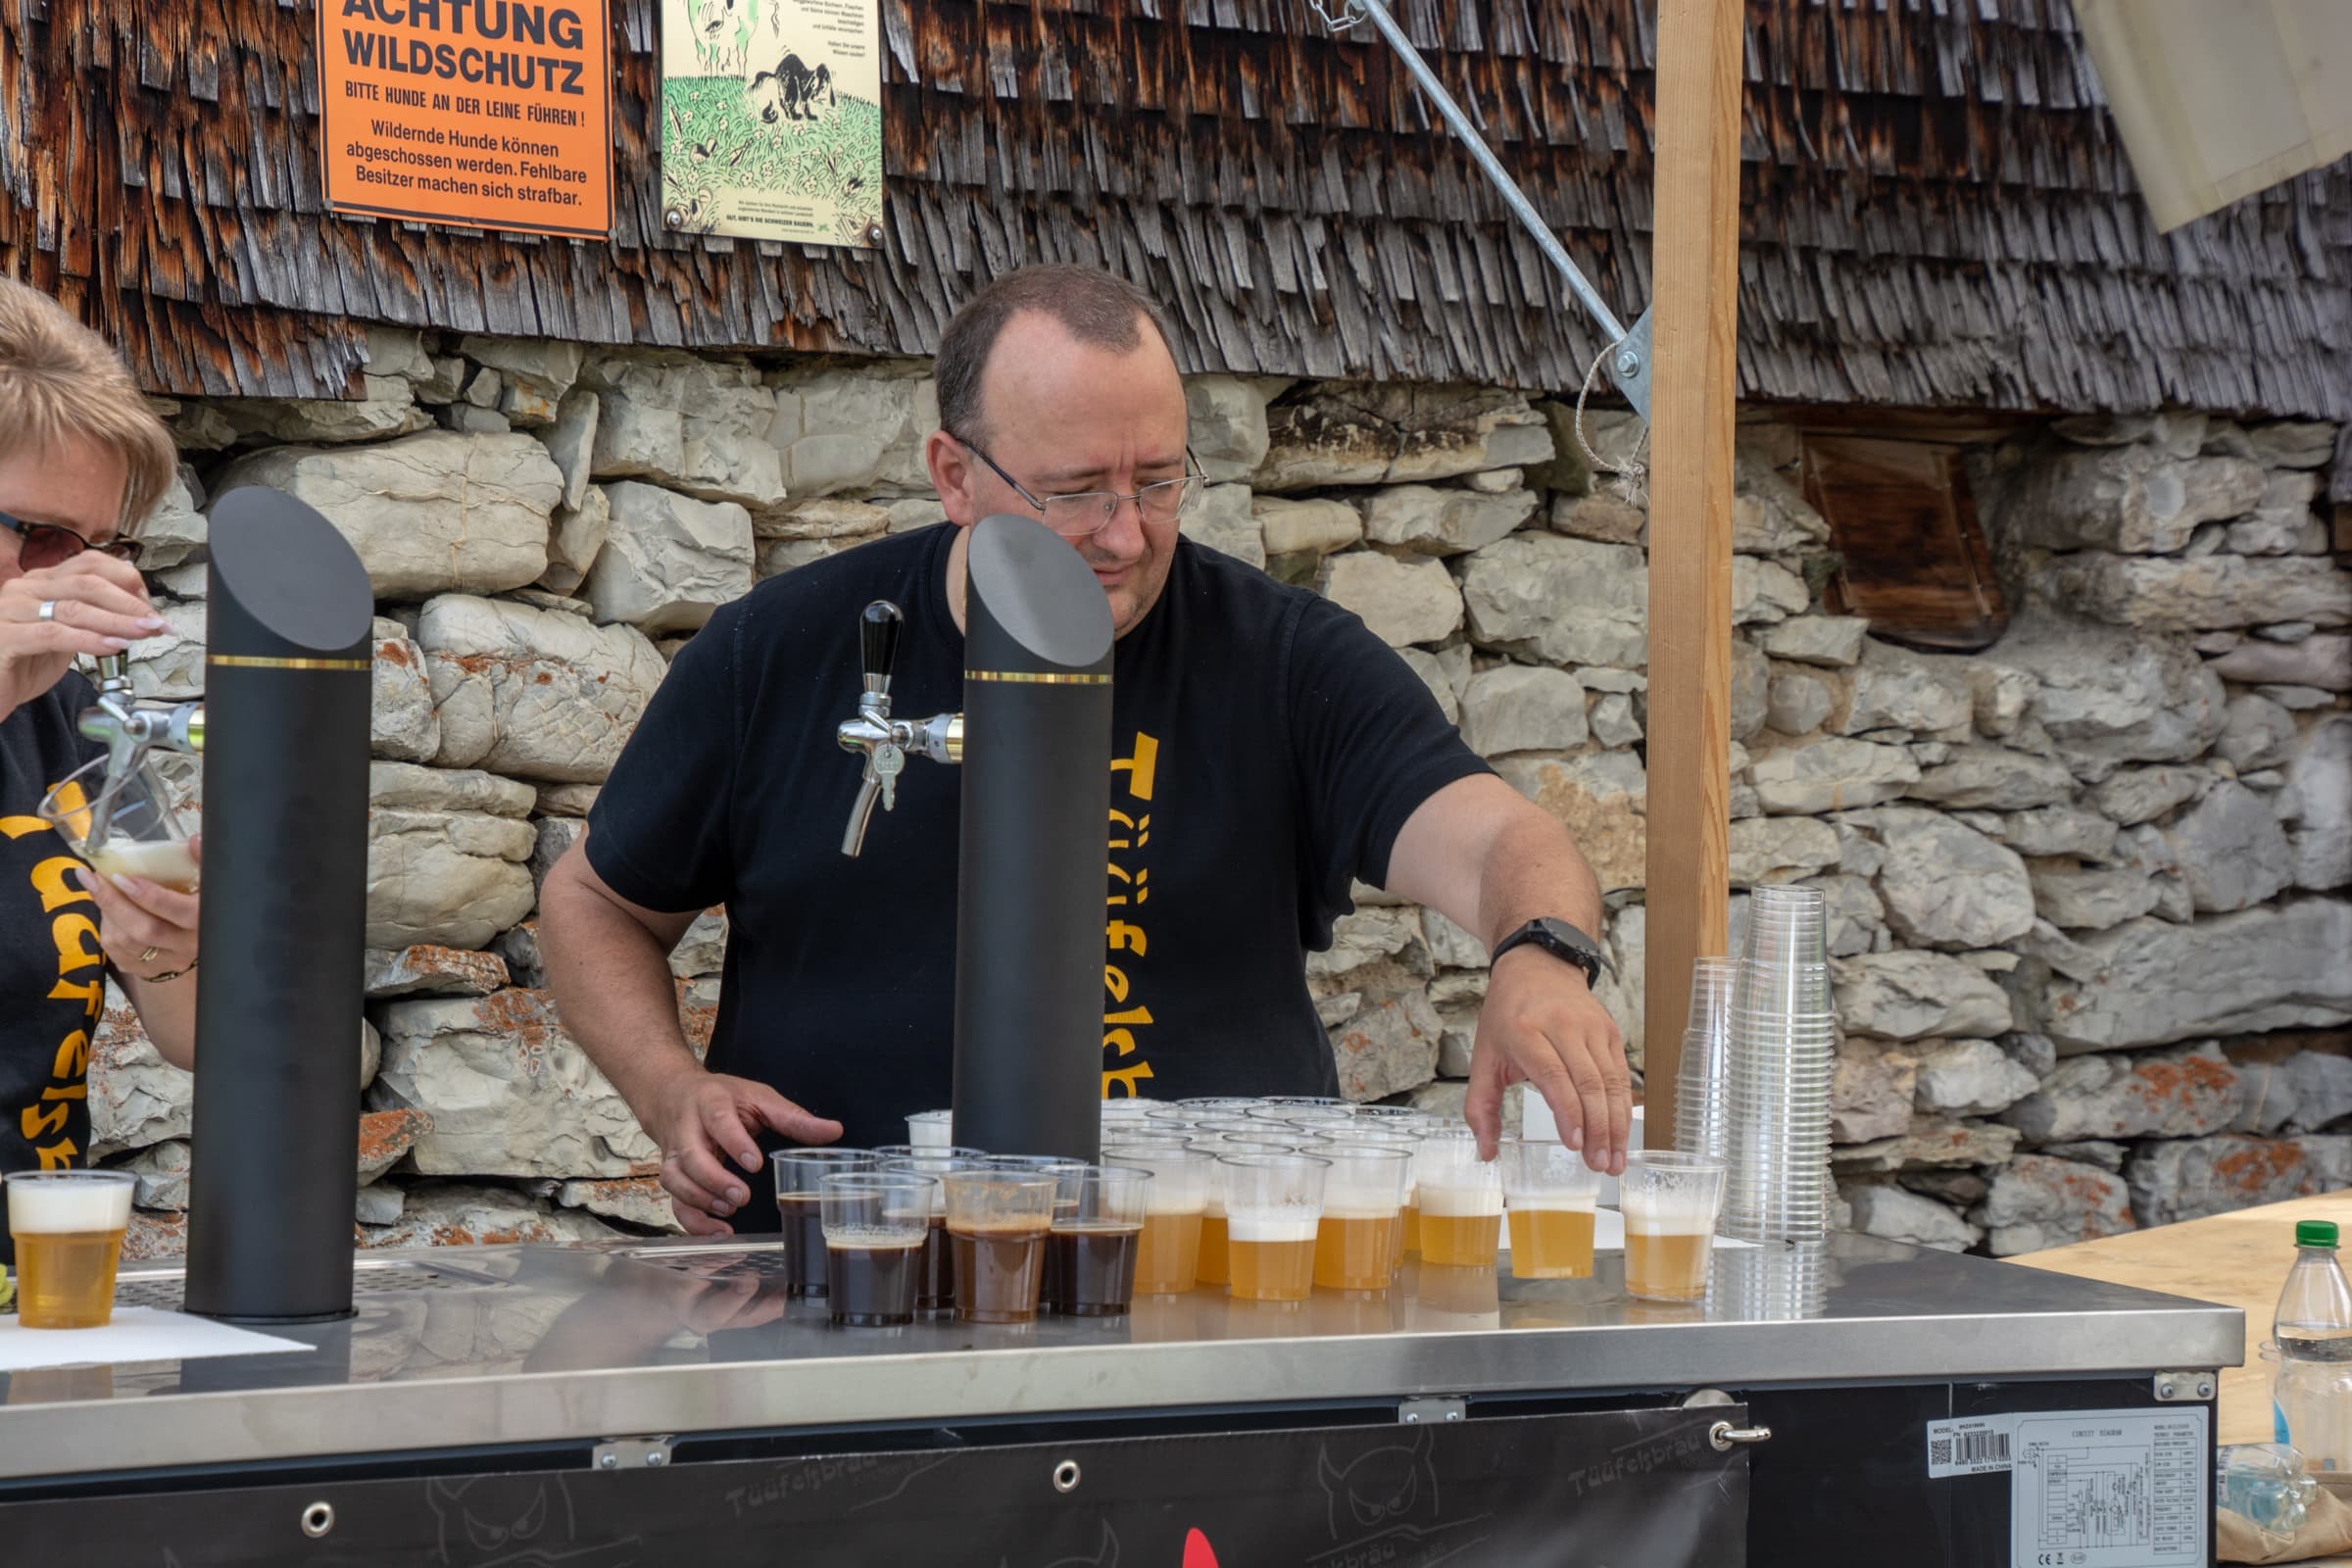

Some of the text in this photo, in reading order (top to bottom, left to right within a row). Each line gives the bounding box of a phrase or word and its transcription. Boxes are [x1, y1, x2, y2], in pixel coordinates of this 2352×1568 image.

[342, 27, 585, 95] WILDSCHUTZ
[345, 79, 379, 101] BITTE
[385, 86, 426, 108] HUNDE
[432, 93, 451, 111] AN
[456, 96, 480, 115] DER
[486, 100, 520, 120] LEINE
[527, 102, 577, 126] FÜHREN
[370, 119, 560, 158] Wildernde Hunde können
[346, 140, 587, 184] abgeschossen werden. Fehlbare
[356, 164, 583, 206] Besitzer machen sich strafbar.
